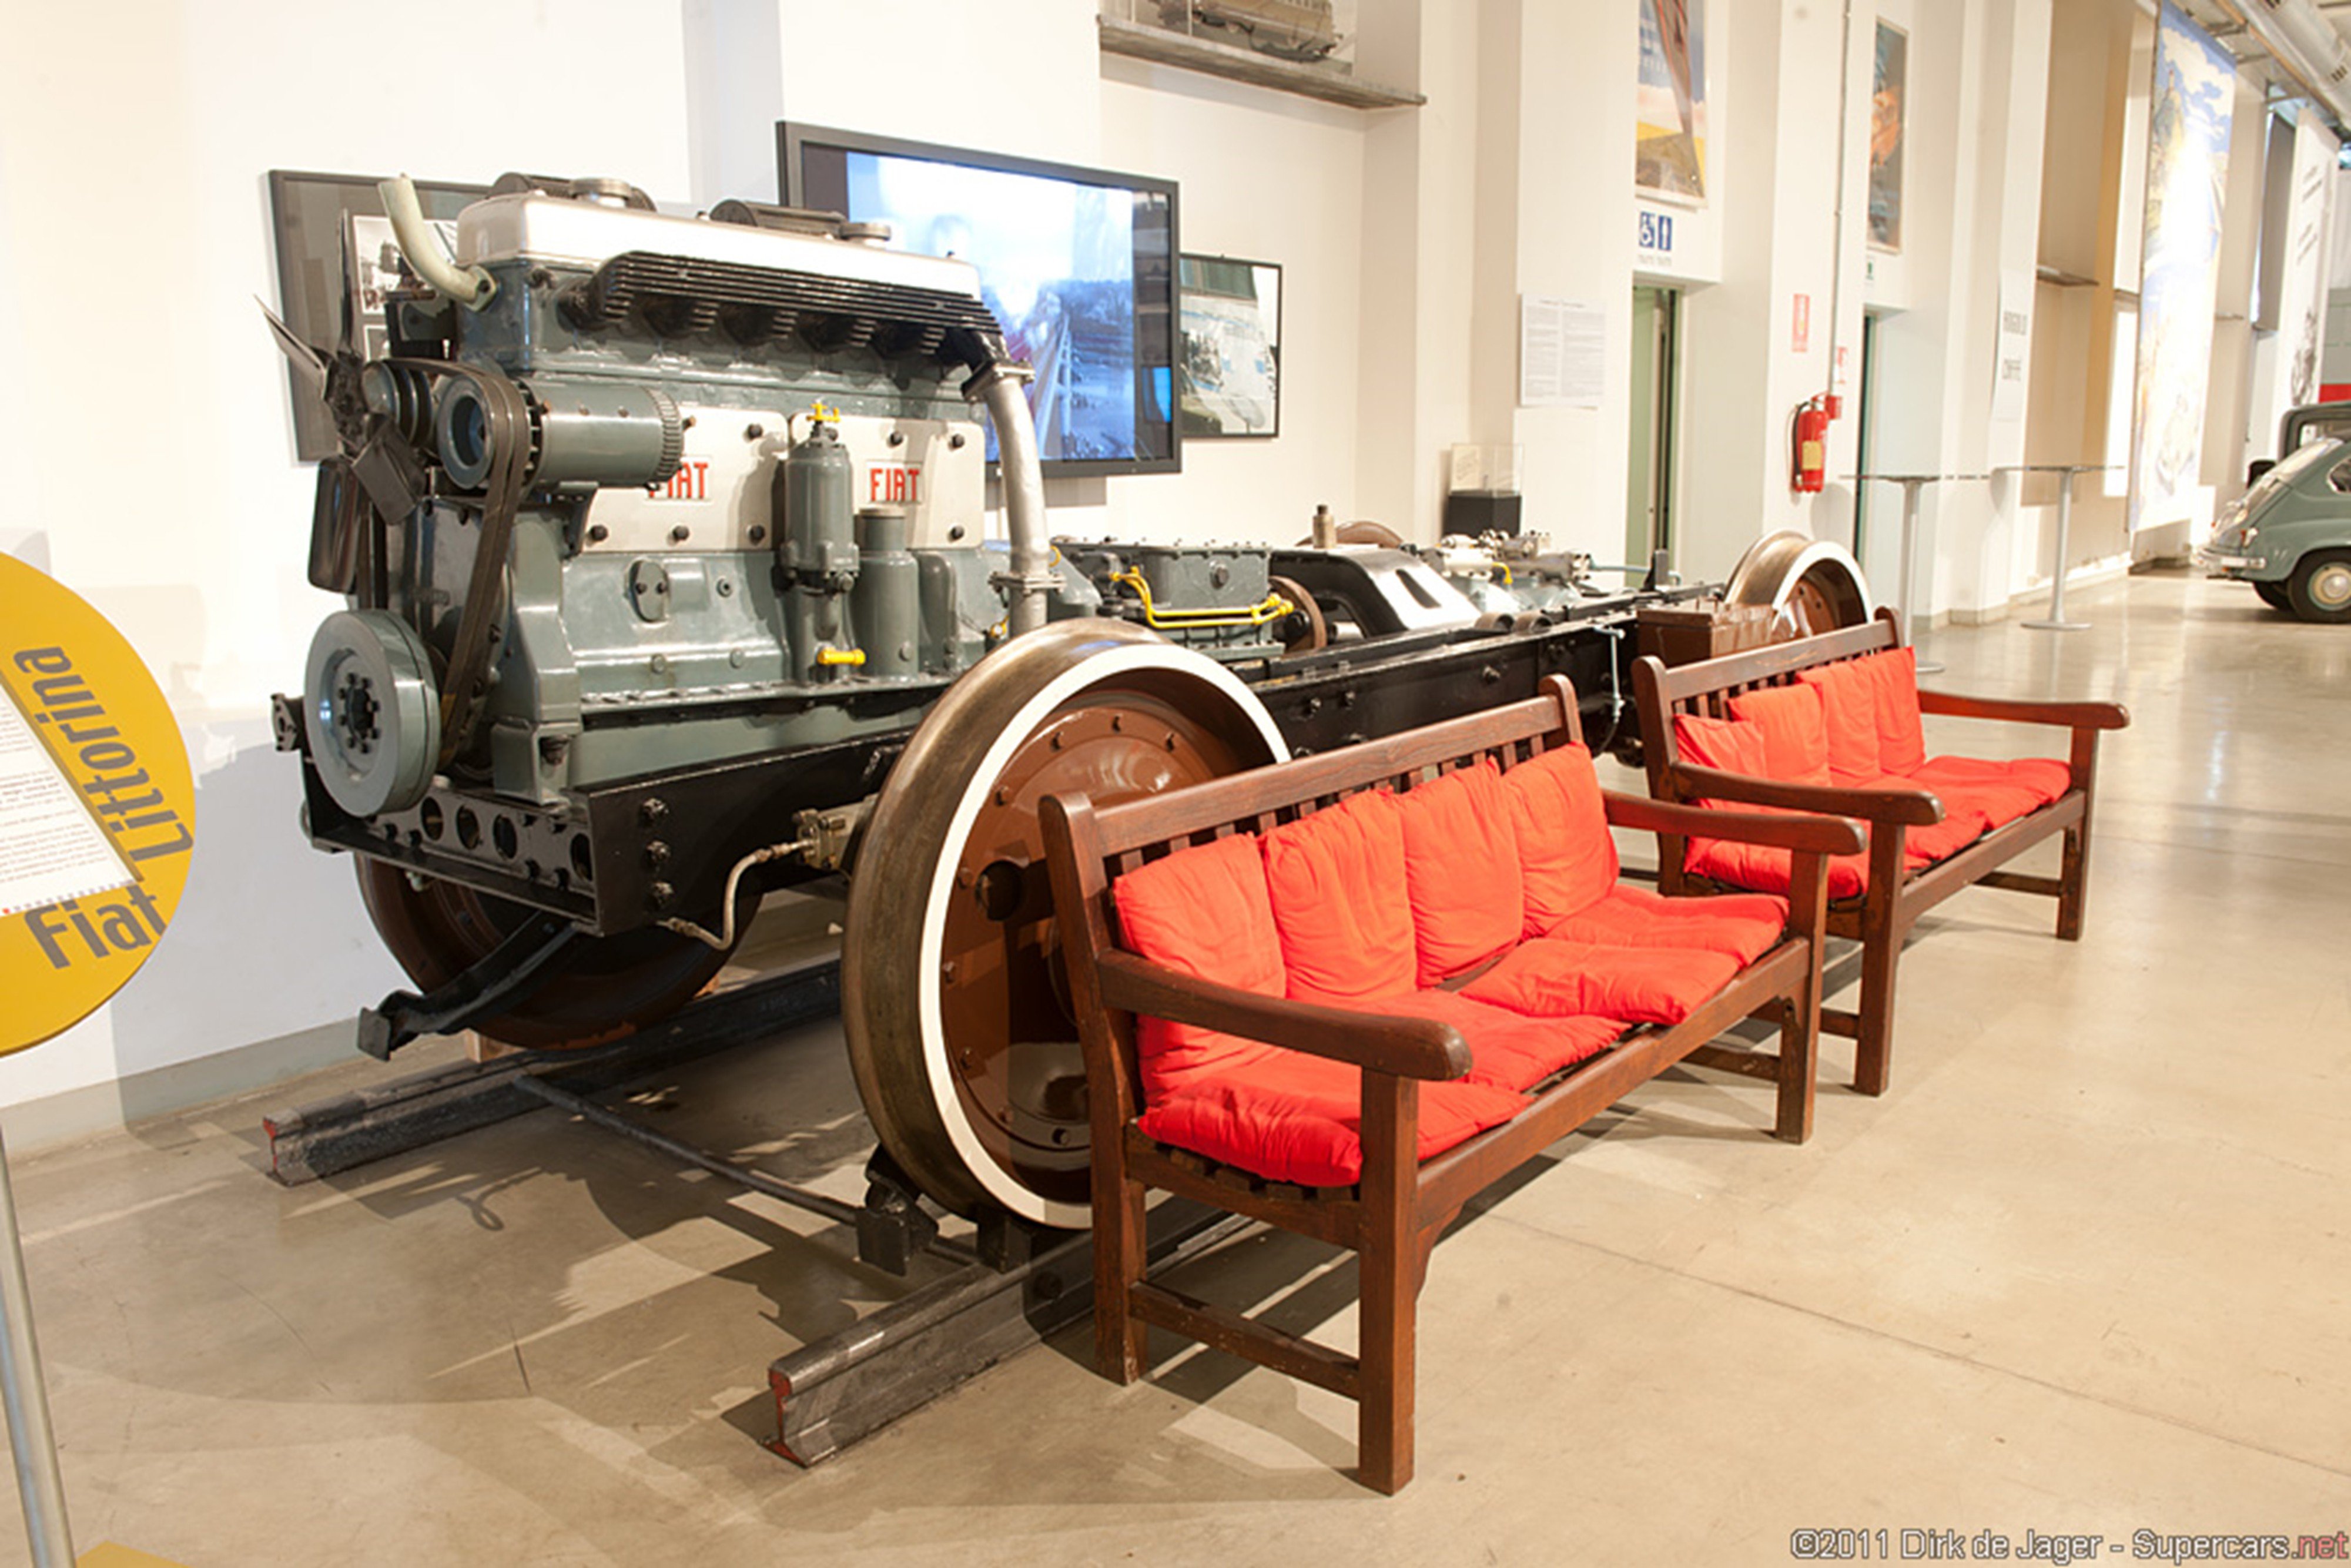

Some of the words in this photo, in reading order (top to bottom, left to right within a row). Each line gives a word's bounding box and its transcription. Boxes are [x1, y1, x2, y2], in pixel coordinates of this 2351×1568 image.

[648, 462, 709, 498] IAT
[870, 468, 920, 502] FIAT
[13, 646, 193, 862] Littorina
[24, 884, 167, 969] Fiat
